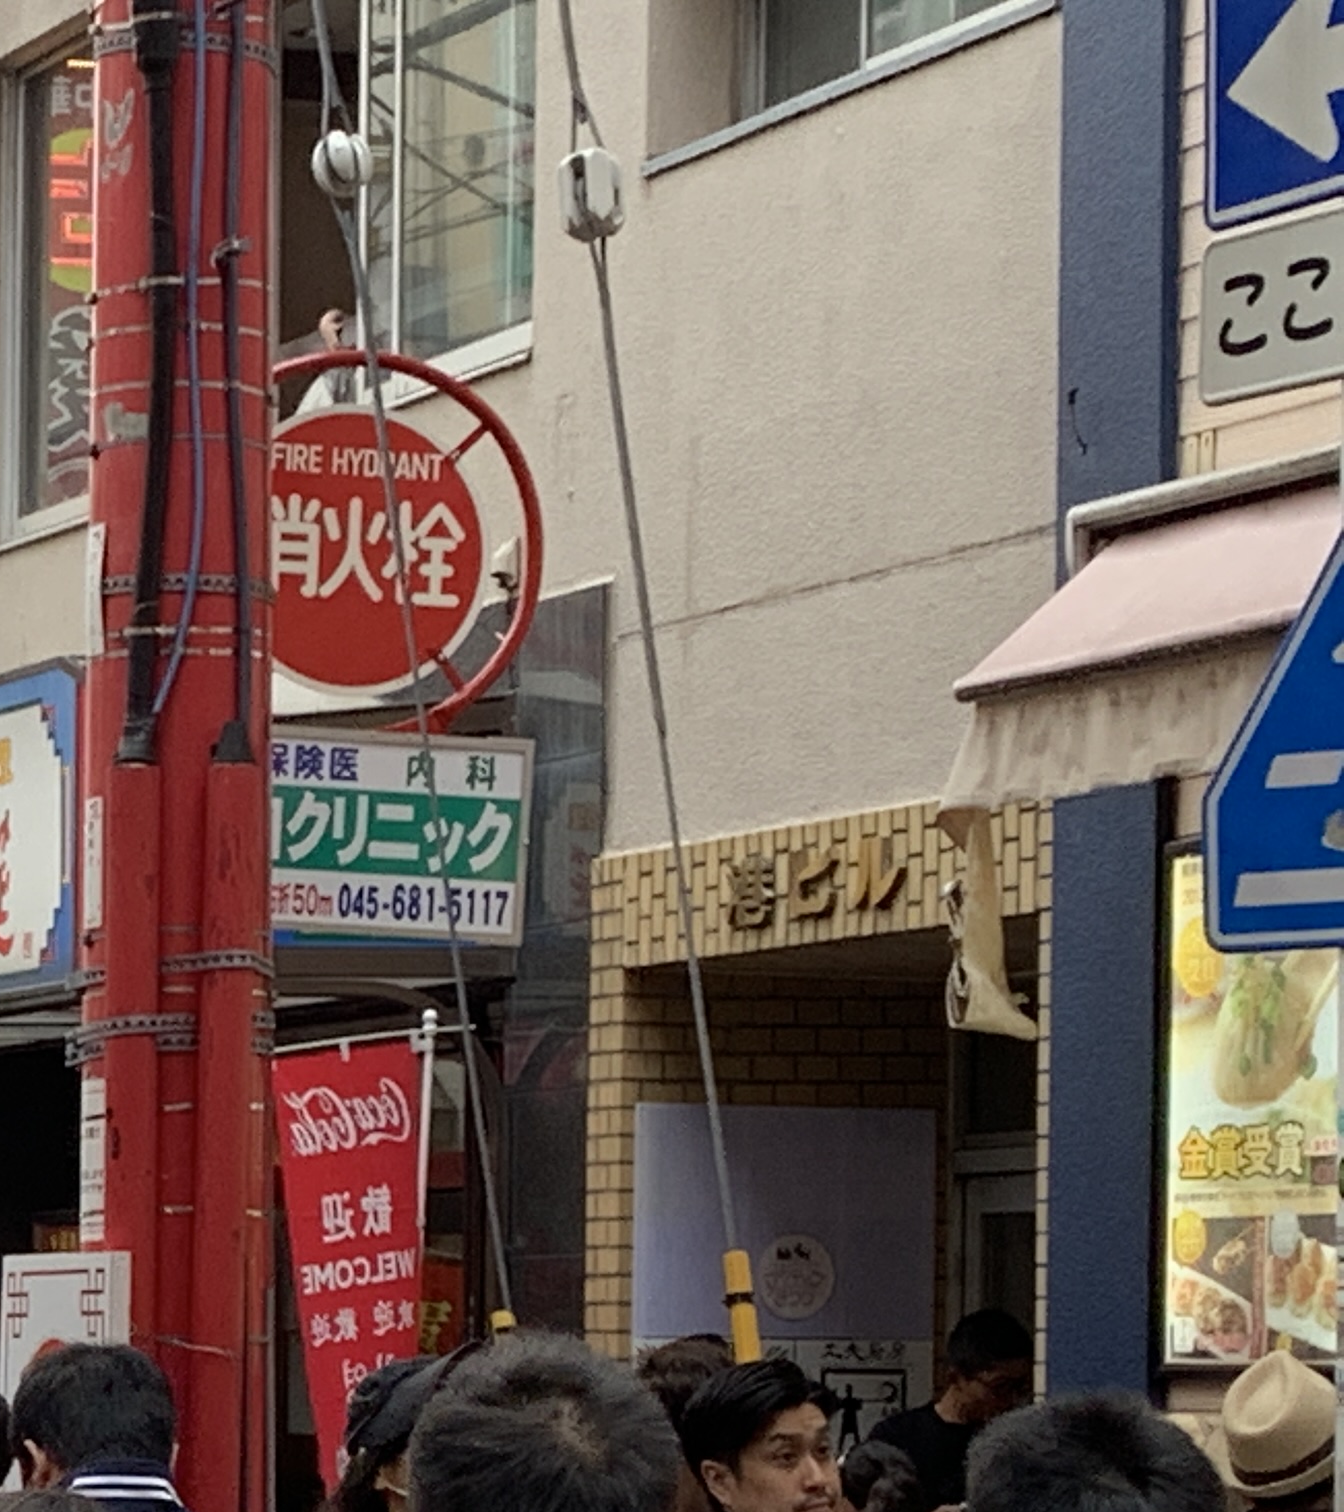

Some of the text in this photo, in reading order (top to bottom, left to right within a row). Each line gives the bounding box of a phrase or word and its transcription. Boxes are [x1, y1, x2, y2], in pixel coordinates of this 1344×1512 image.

[272, 442, 323, 474] FIRE
[338, 883, 509, 927] 045-681-5117
[1178, 1121, 1305, 1180] 金賞受賞
